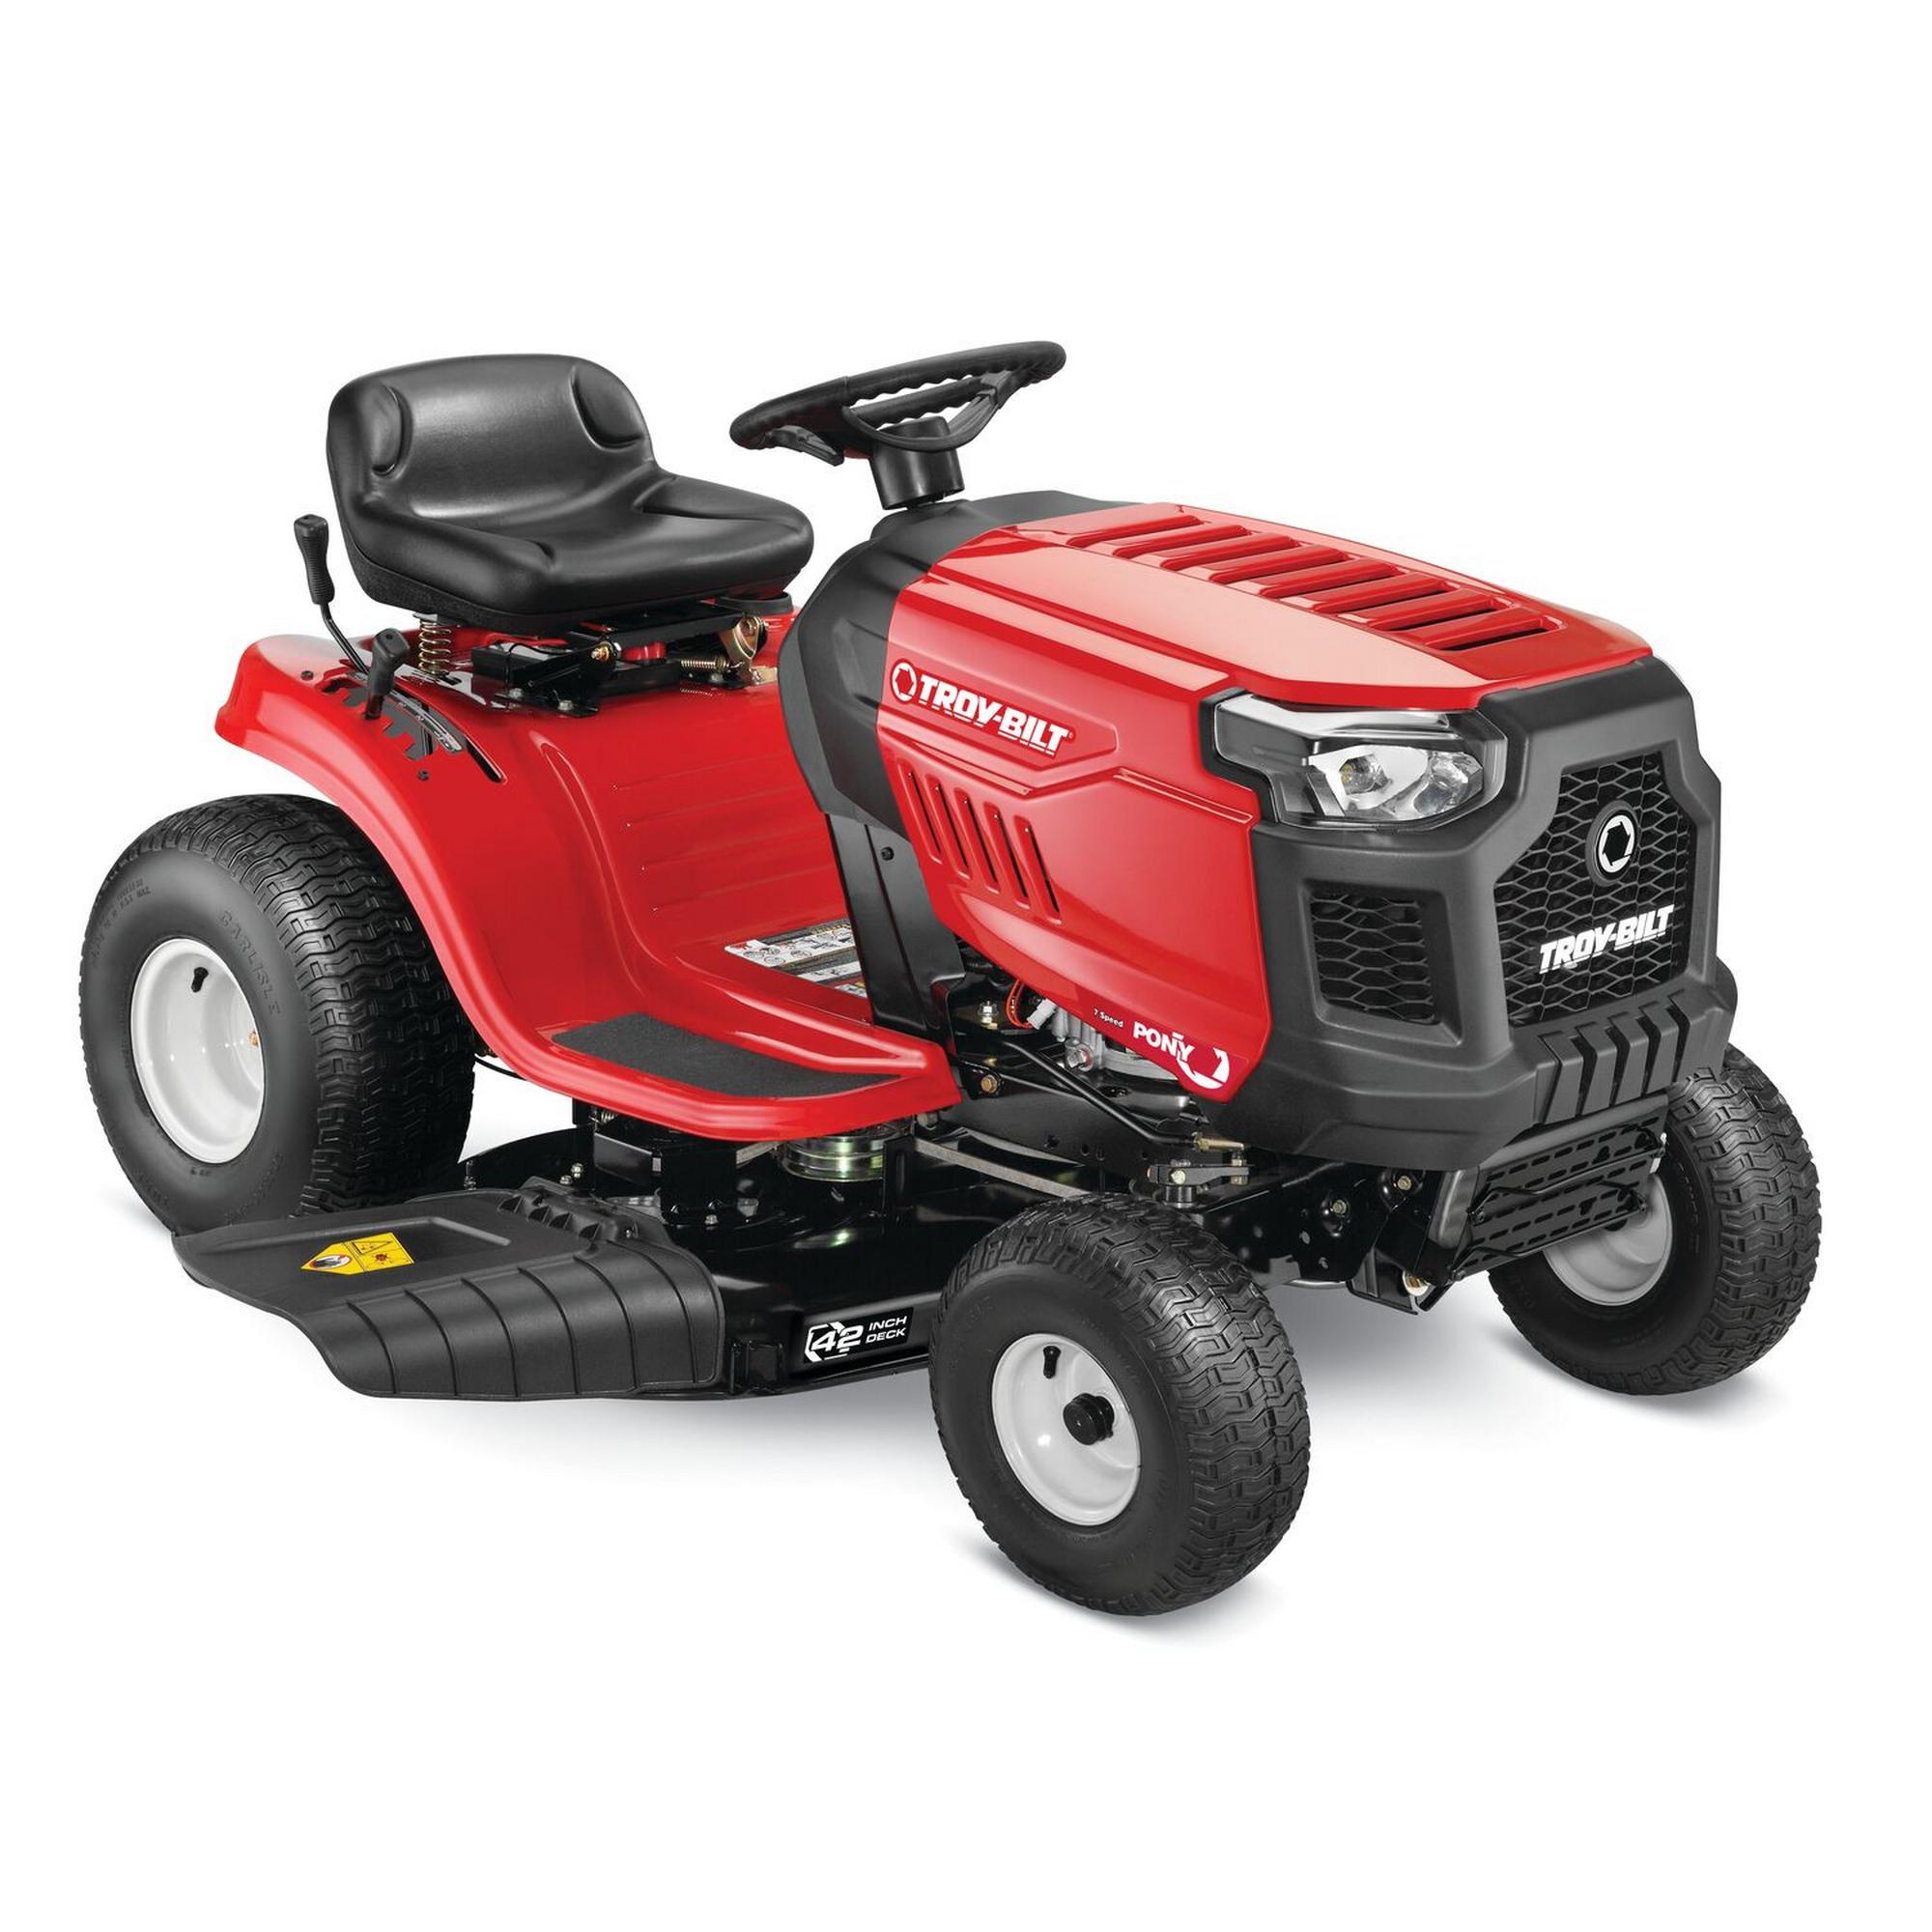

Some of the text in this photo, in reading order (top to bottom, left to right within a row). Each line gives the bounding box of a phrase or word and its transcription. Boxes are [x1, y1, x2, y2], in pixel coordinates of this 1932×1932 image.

[919, 674, 1069, 755] TROY-BILT
[1539, 904, 1675, 975] TROY-BILT
[1099, 1011, 1124, 1028] Speed
[1132, 1021, 1195, 1062] PONY
[811, 1316, 908, 1352] 42 INCH
[865, 1327, 907, 1344] DECK
